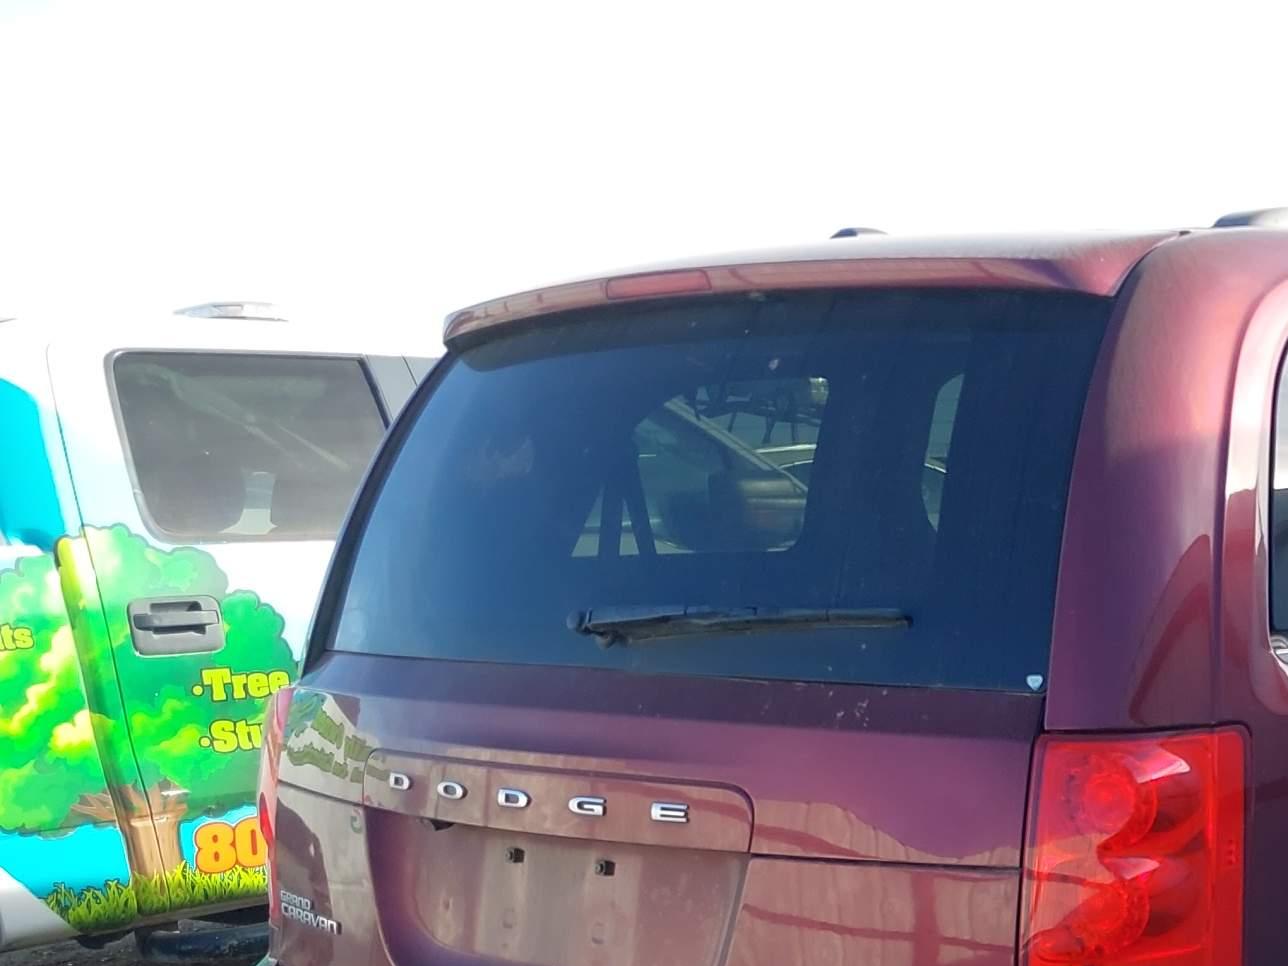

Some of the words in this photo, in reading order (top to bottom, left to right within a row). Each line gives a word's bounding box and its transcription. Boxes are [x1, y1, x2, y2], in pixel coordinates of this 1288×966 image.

[0, 623, 35, 651] ts
[389, 772, 689, 823] DODGE
[195, 815, 269, 873] 80
[280, 890, 311, 911] GRAND
[281, 902, 337, 935] CARAVAN
